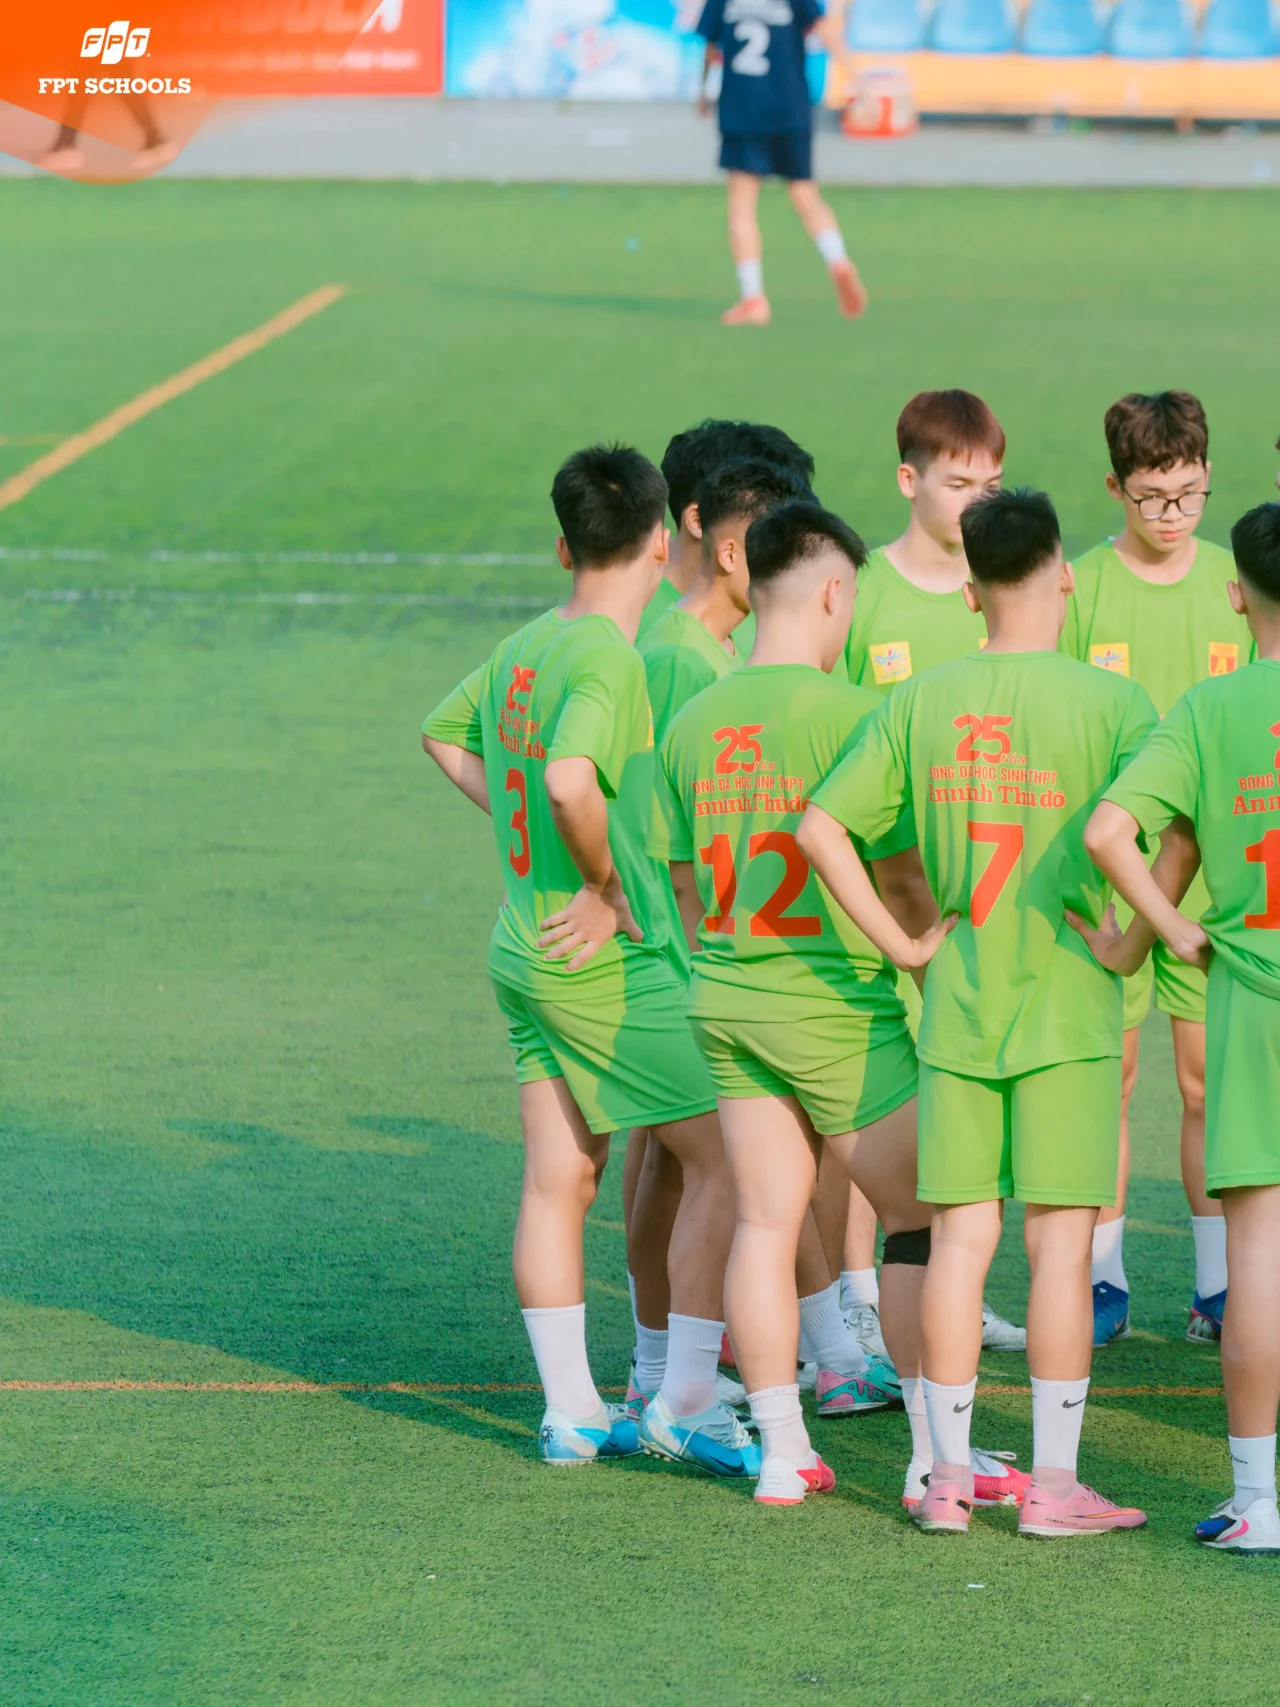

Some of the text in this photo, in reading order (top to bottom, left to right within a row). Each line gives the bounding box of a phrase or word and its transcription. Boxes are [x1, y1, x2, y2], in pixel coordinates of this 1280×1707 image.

[734, 20, 771, 76] 2
[506, 663, 537, 716] 25
[712, 723, 764, 775] 25
[952, 713, 1013, 764] 25
[778, 776, 805, 792] THPT
[1000, 767, 1028, 783] SINH
[1029, 769, 1058, 785] THPT
[1238, 774, 1274, 791] BÓNG
[505, 768, 530, 878] 3
[699, 831, 822, 937] 12
[967, 820, 1024, 928] 7
